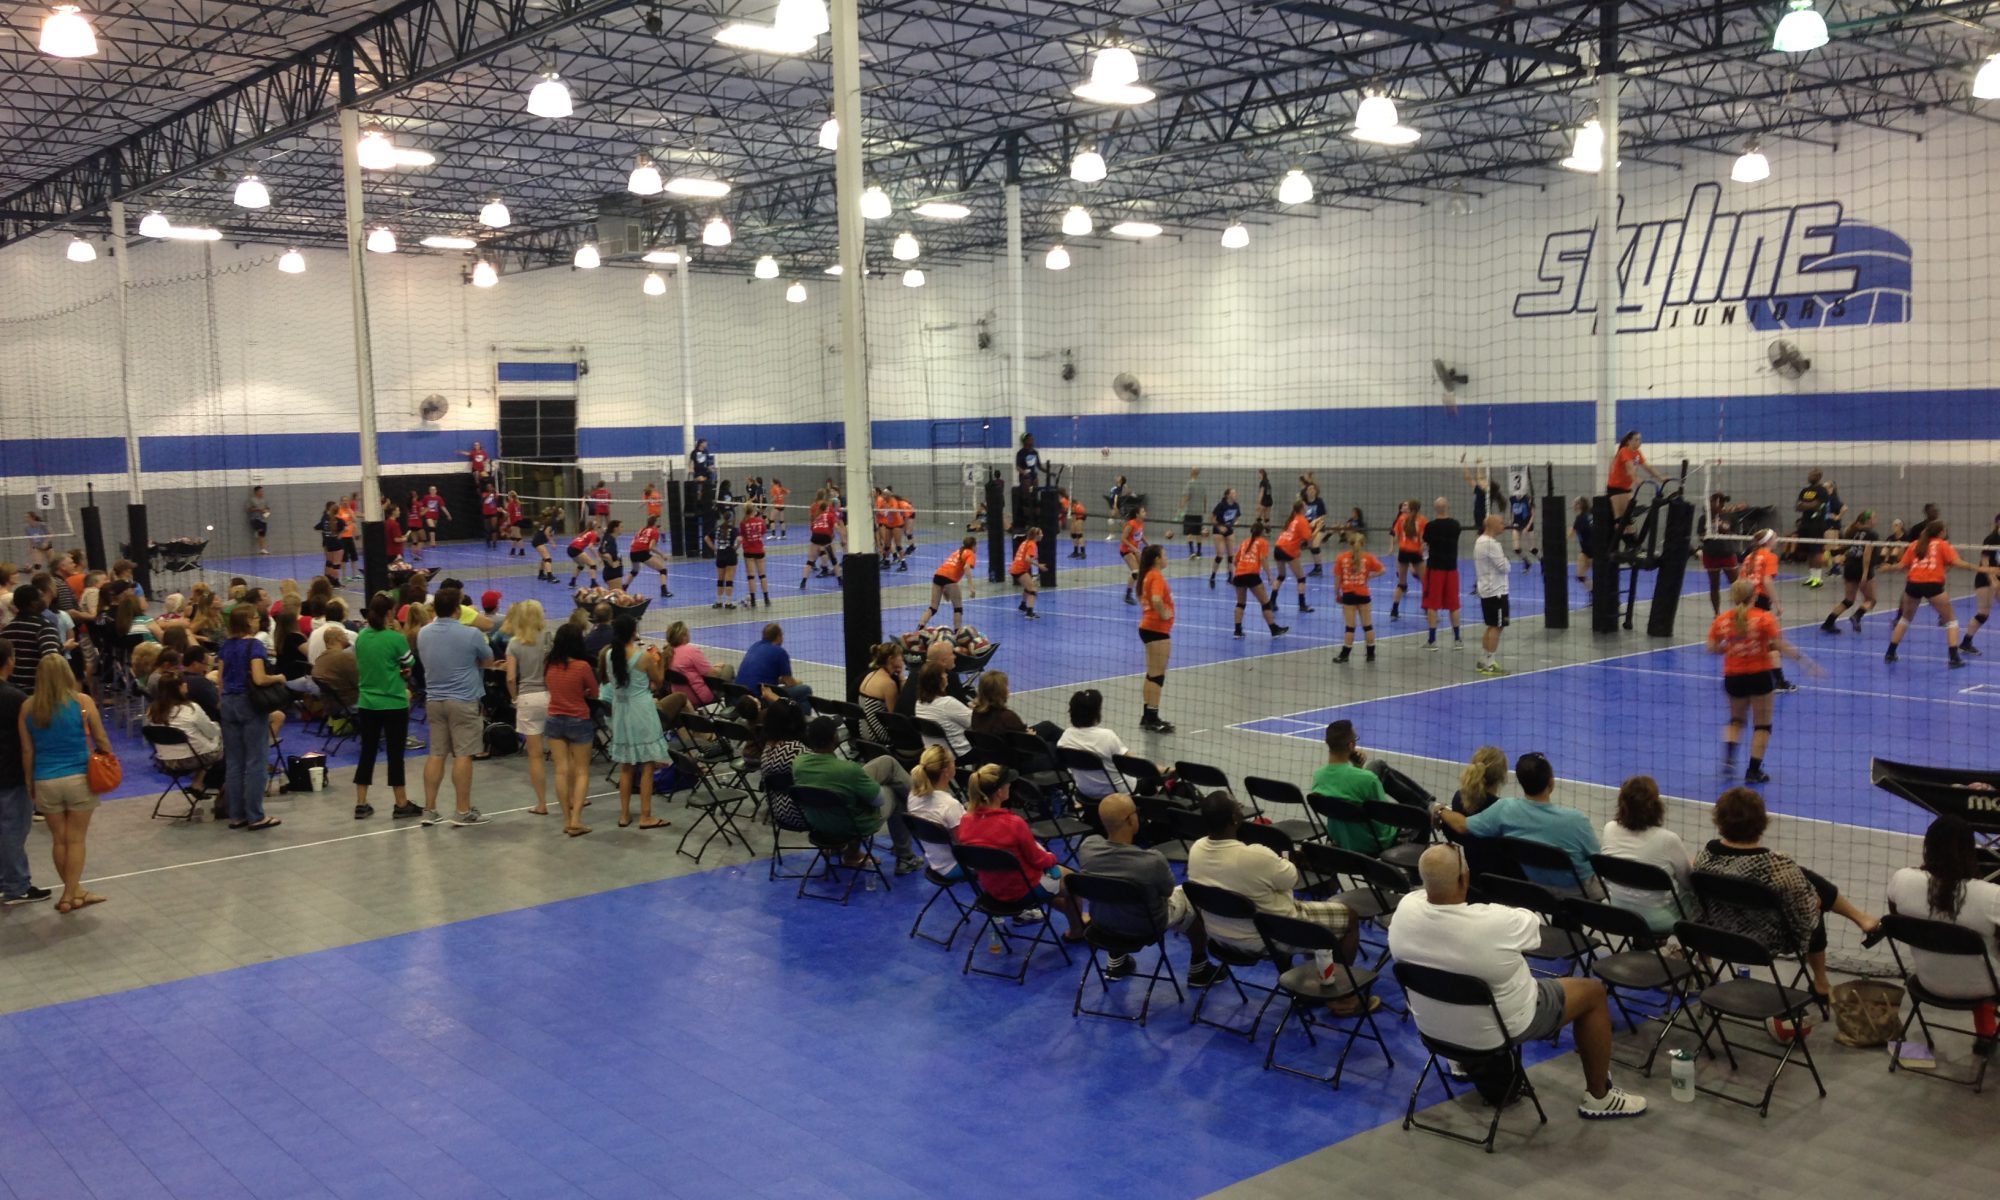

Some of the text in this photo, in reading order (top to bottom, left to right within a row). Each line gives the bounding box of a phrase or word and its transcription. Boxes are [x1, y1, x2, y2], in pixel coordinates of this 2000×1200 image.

[1669, 298, 1847, 327] JUNIORS
[1514, 475, 1522, 490] 3
[42, 494, 50, 506] 6
